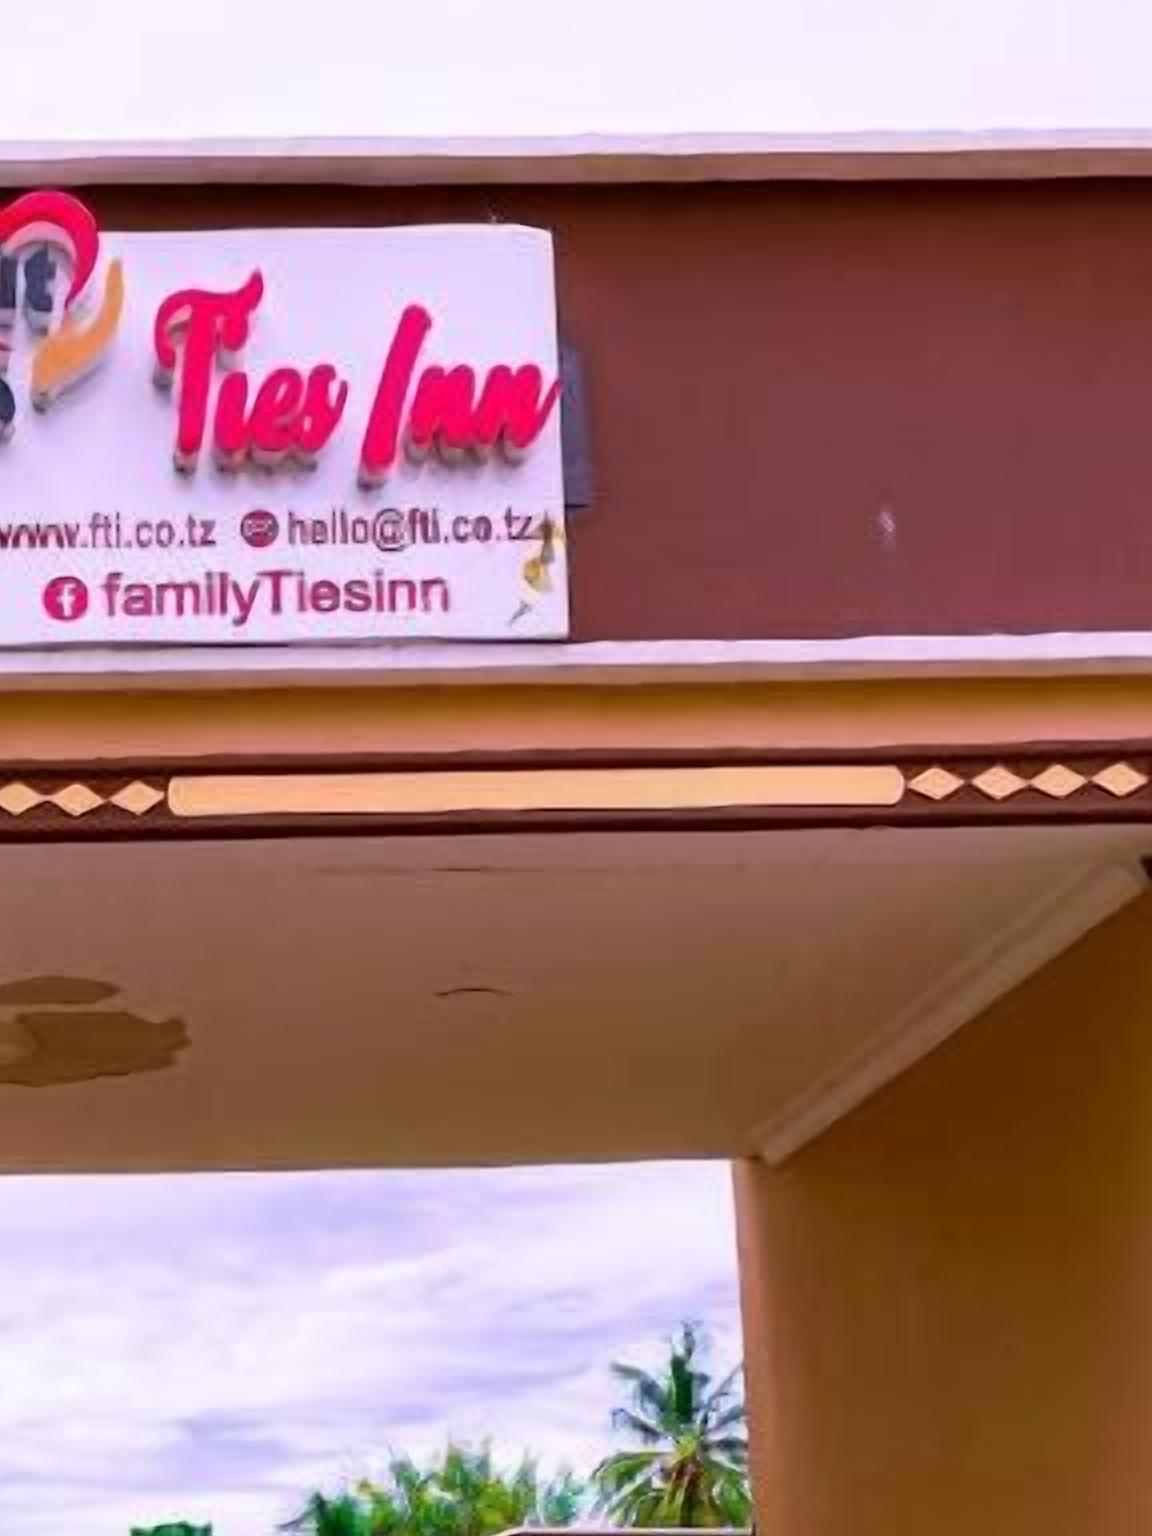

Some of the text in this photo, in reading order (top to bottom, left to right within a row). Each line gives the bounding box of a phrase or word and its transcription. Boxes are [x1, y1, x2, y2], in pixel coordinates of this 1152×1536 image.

[154, 268, 347, 454] Ties
[361, 305, 564, 470] Inn
[288, 507, 536, 551] hello@fti.co.tz
[102, 570, 449, 626] familyTiesinn
